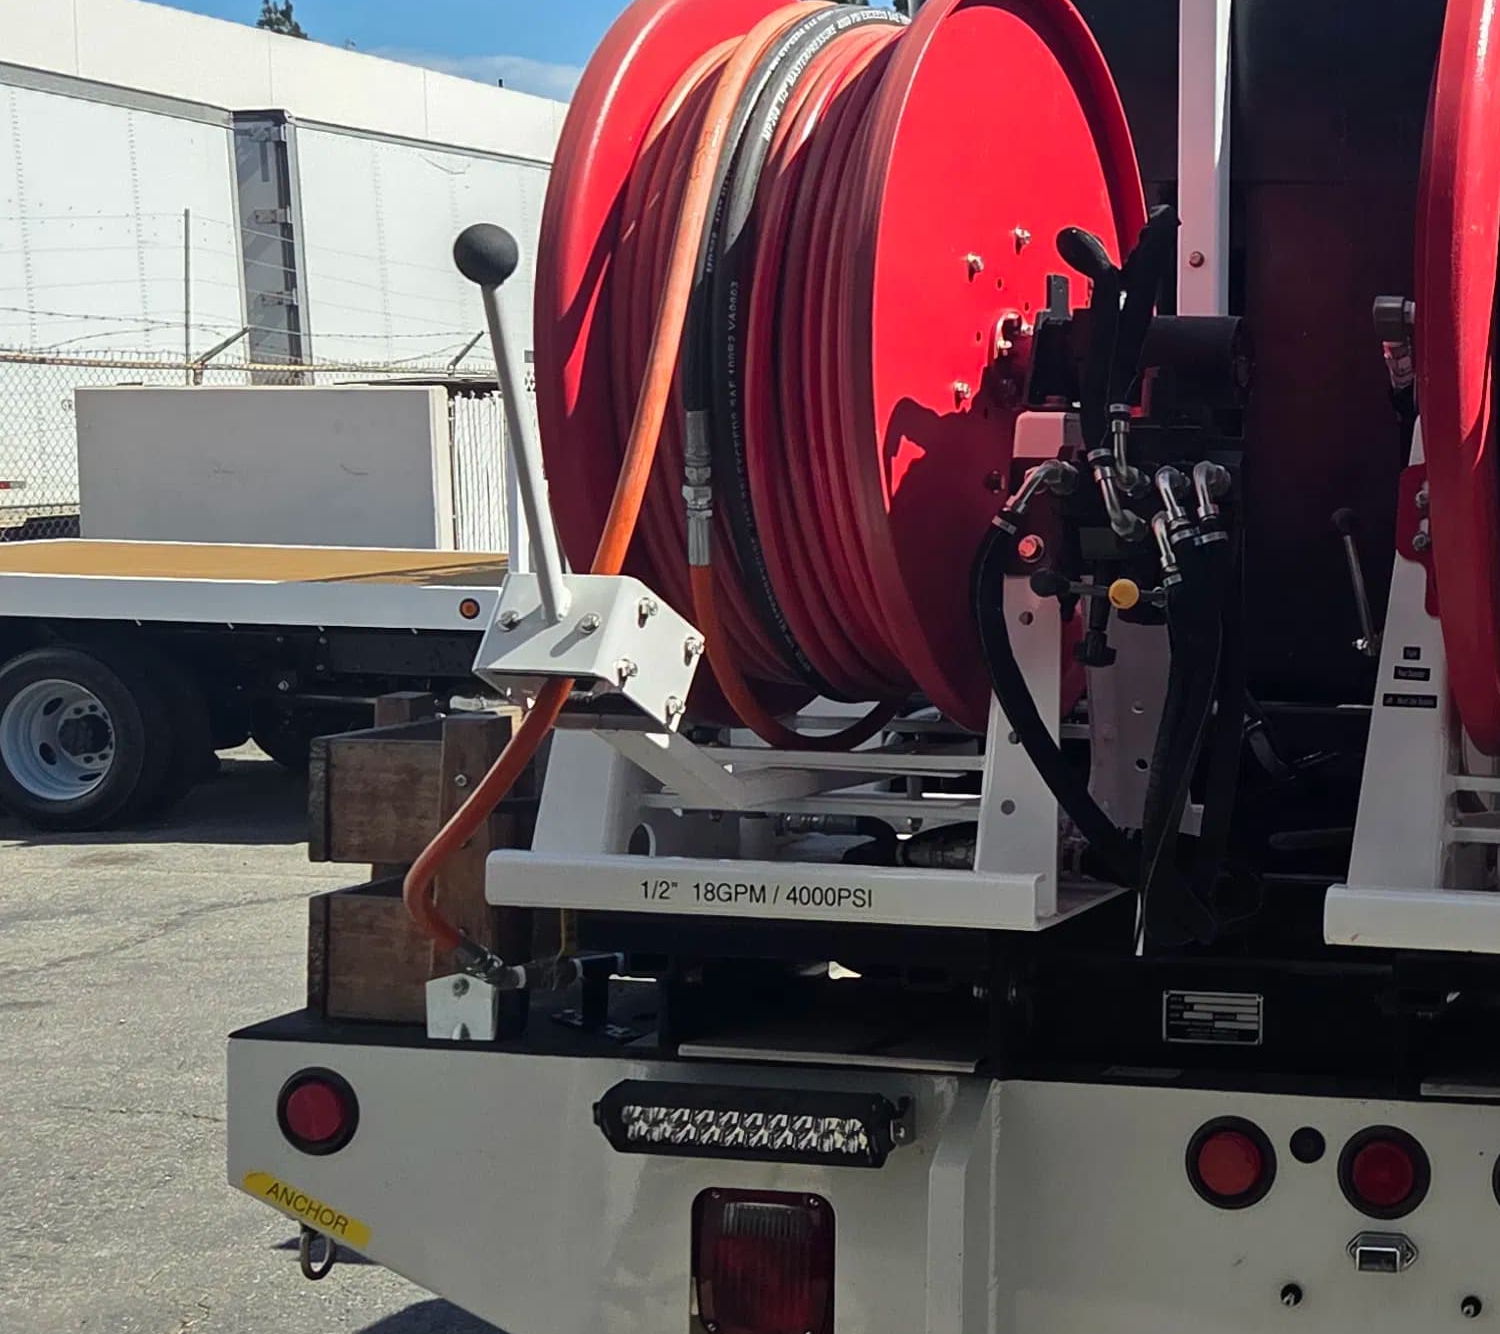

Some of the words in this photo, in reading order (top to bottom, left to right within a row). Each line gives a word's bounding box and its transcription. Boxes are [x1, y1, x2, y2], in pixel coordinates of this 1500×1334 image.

[640, 880, 678, 900] 1/2"
[693, 882, 766, 904] 18GPM
[786, 886, 872, 908] 4000PSI
[266, 1182, 348, 1235] ANCHOR
